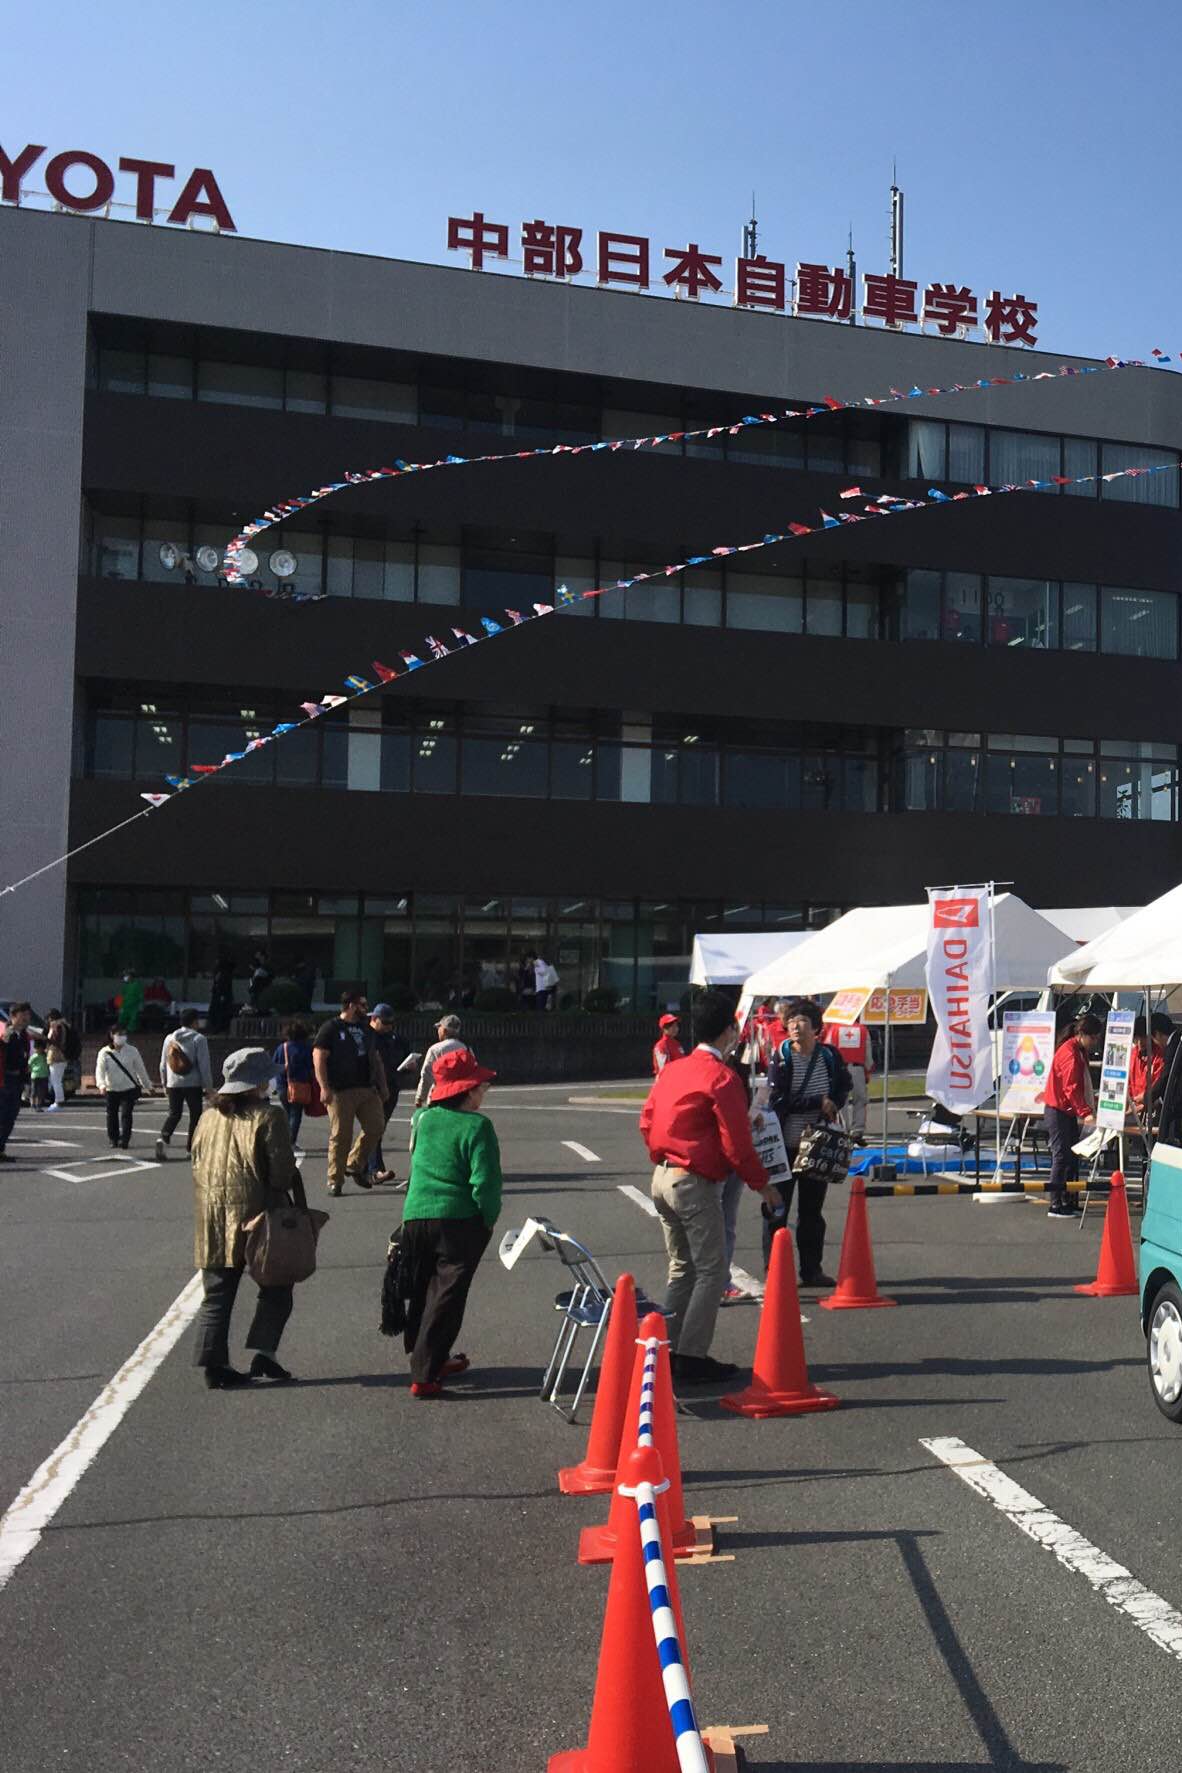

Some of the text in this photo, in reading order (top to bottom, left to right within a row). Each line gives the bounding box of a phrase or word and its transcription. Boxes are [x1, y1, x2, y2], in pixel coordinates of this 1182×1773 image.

[447, 212, 1039, 347] 中部日本自動車学校
